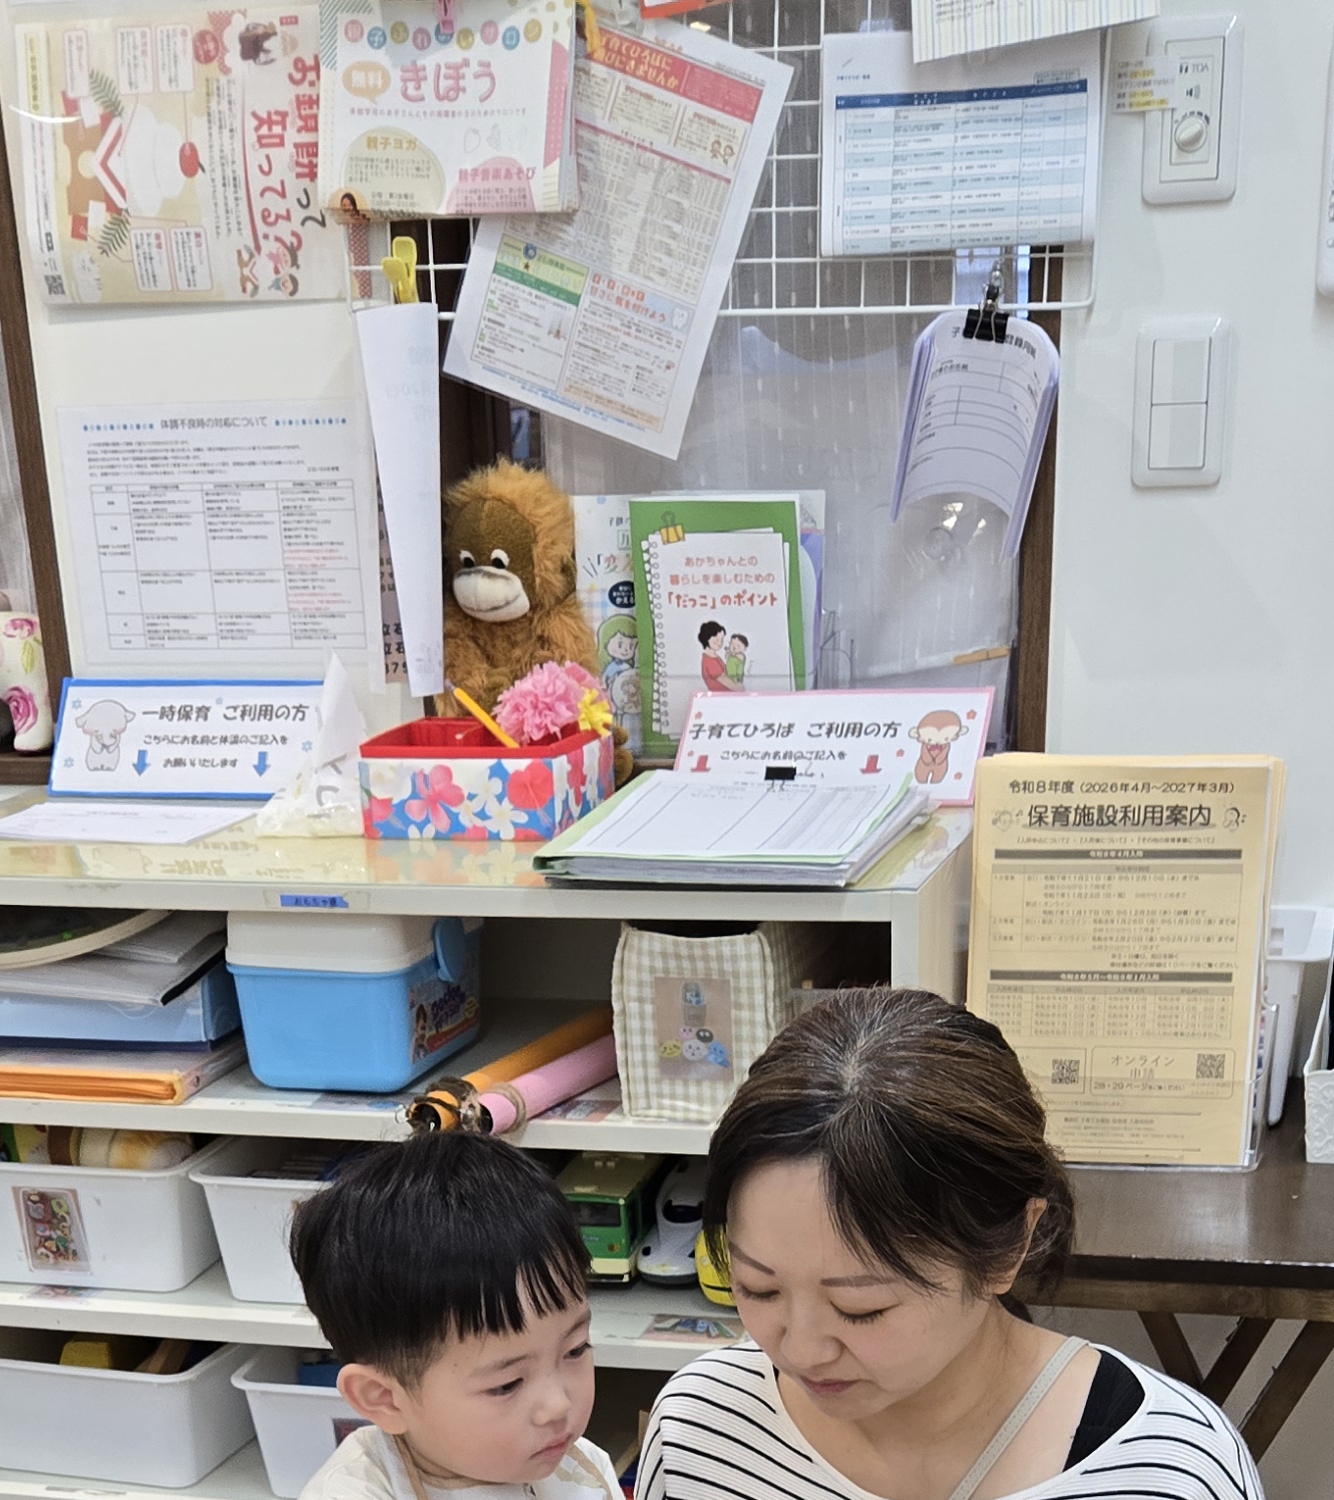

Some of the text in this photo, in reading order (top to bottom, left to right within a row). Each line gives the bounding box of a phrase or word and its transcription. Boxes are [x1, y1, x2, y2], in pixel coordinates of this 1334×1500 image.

[400, 58, 497, 103] きぼう
[684, 555, 759, 568] あかちゃんとの
[669, 572, 776, 586] 暮らしを楽しむための
[668, 589, 778, 610] 「だっこ」のポイント
[142, 704, 310, 722] 一時保育 ご利用の方
[689, 721, 902, 740] 子育てひろば ご利用の方
[143, 734, 289, 746] こちらにお名前と体温のご記入を
[720, 750, 848, 761] こちらにお名前のご記入を
[1027, 803, 1212, 828] 保育施設利用案内
[1110, 1054, 1176, 1067] オンライン
